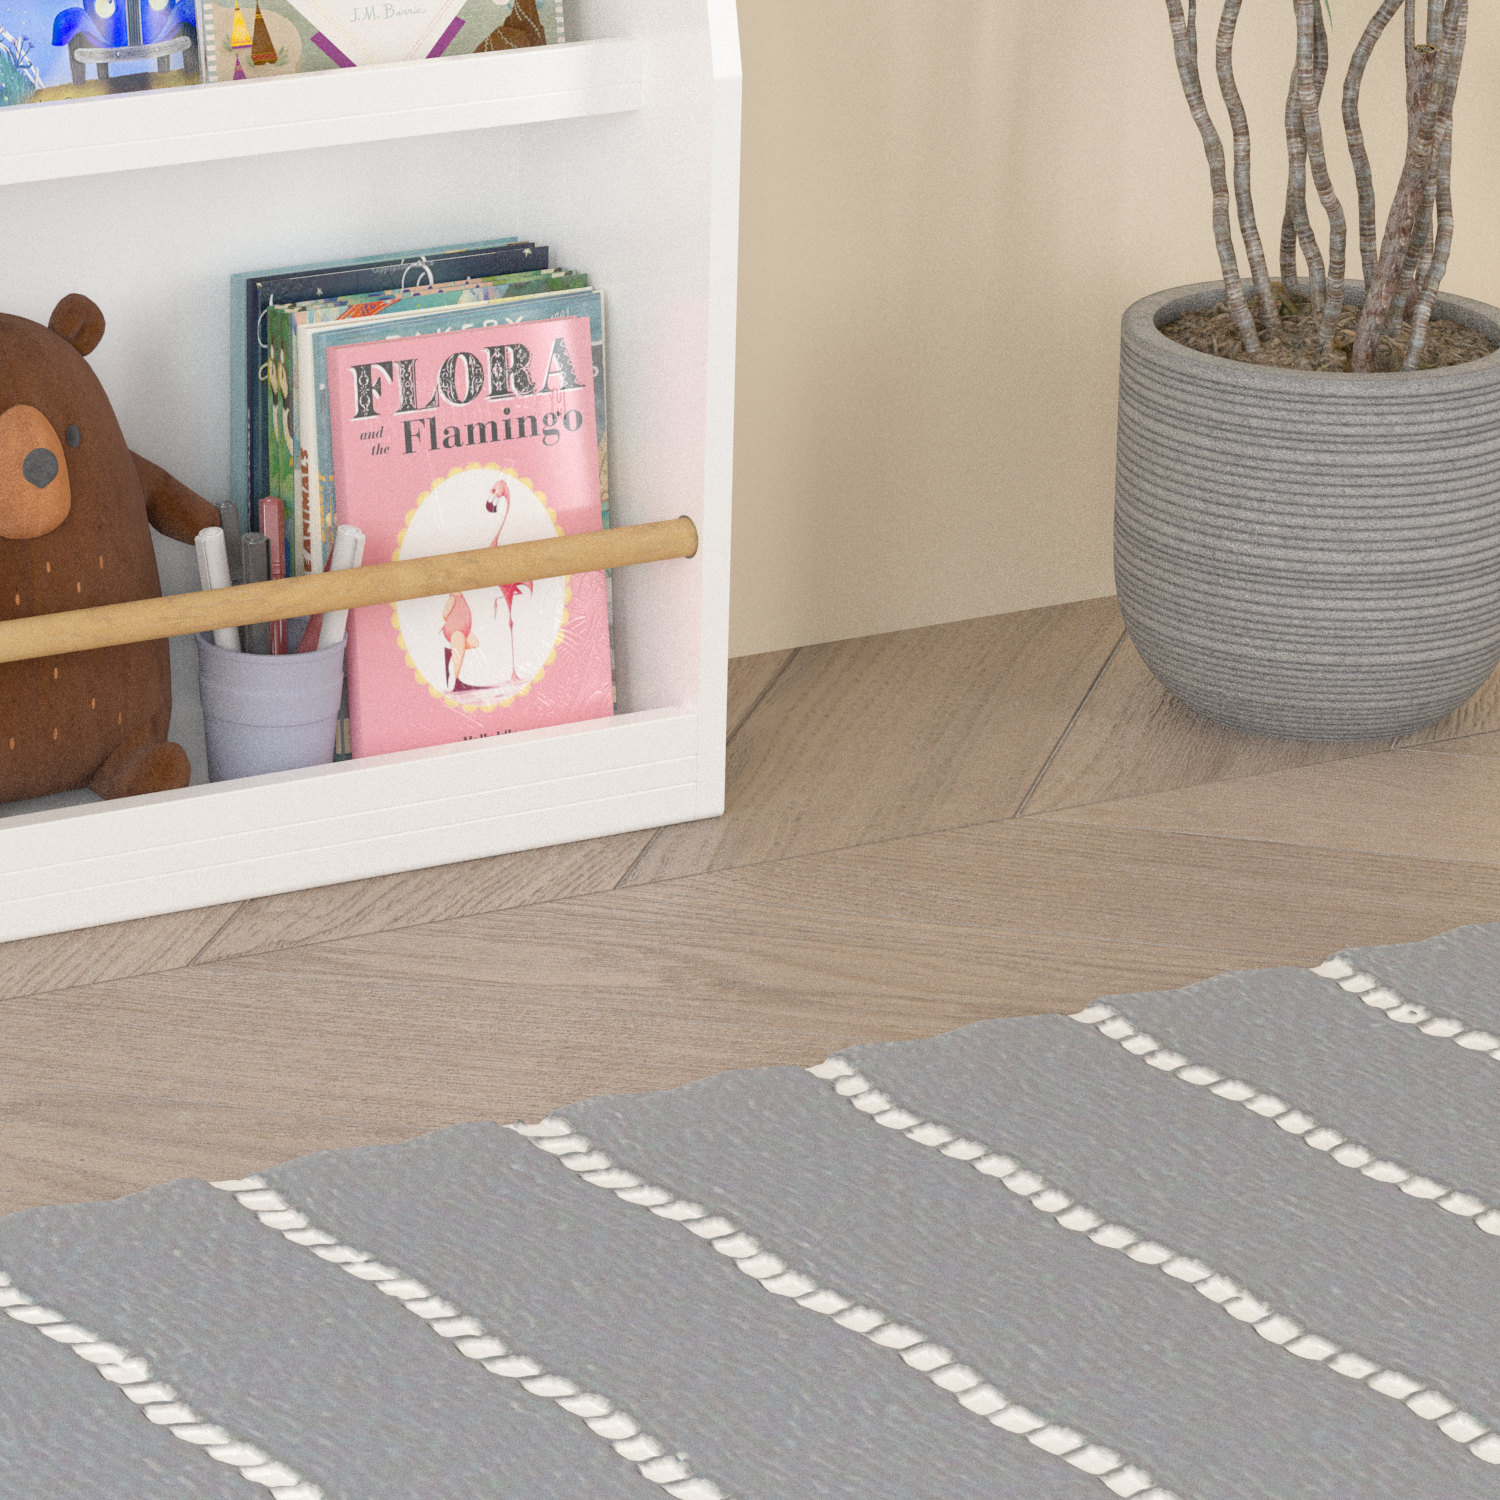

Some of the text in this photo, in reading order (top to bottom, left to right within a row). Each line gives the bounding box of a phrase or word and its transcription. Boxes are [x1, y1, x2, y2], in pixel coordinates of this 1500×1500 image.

[383, 3, 426, 20] Barrie
[348, 337, 587, 422] FLORA
[360, 426, 384, 441] and
[400, 407, 584, 455] Flamingo
[371, 443, 390, 457] the
